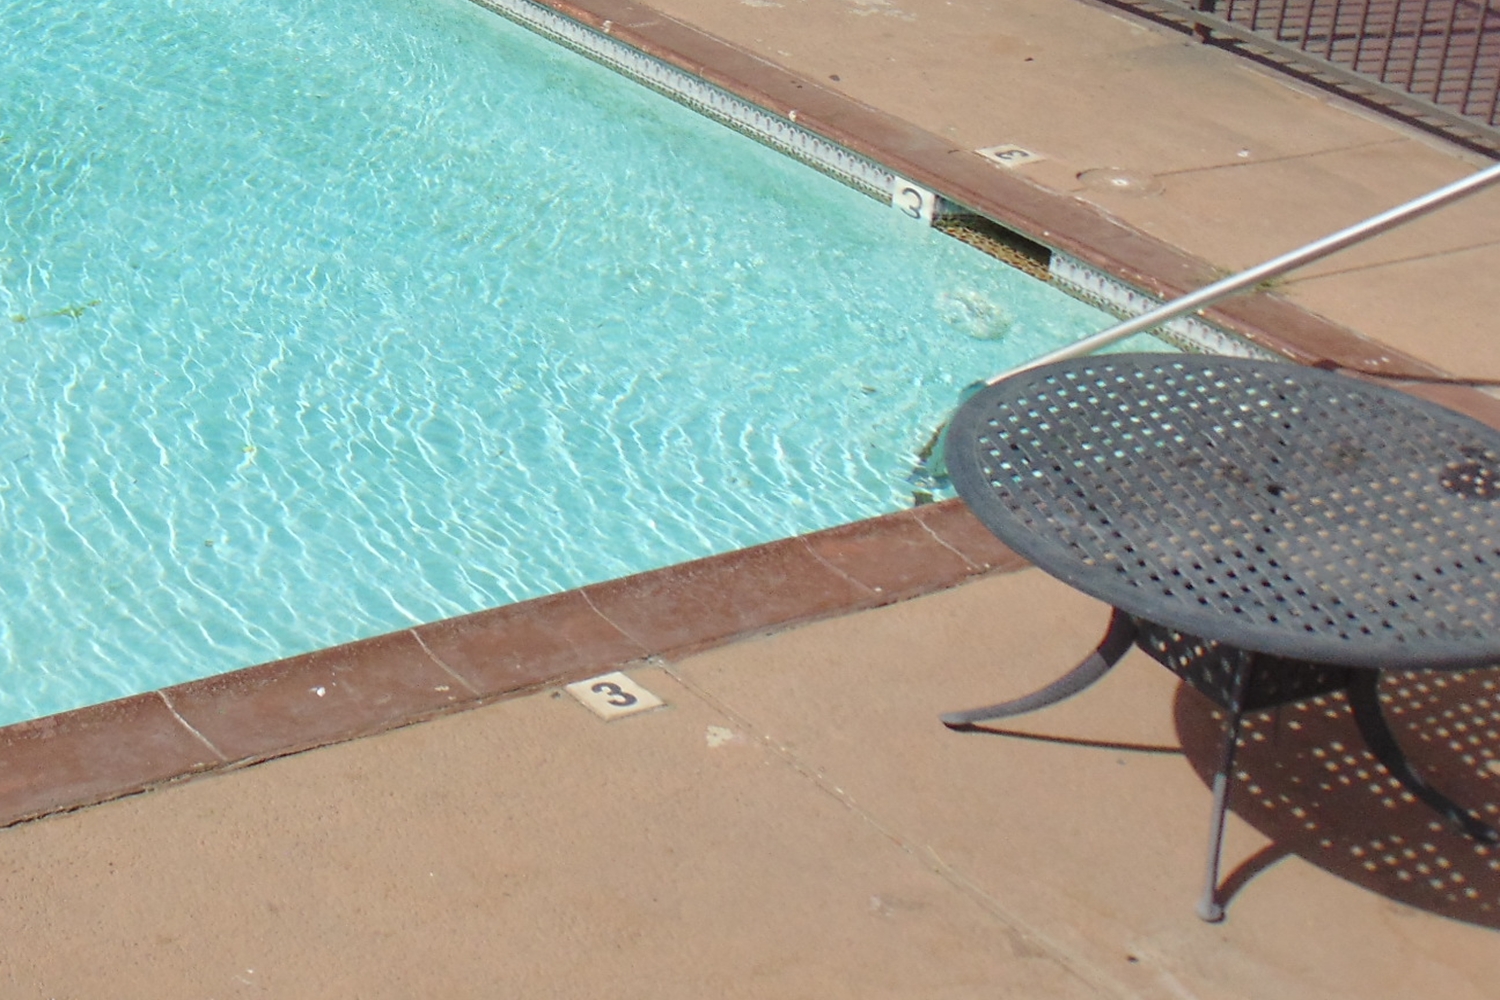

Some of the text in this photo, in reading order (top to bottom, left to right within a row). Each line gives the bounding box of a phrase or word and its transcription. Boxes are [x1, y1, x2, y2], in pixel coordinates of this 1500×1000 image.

[994, 149, 1029, 160] 3
[901, 186, 922, 219] 3
[590, 681, 638, 707] 3
